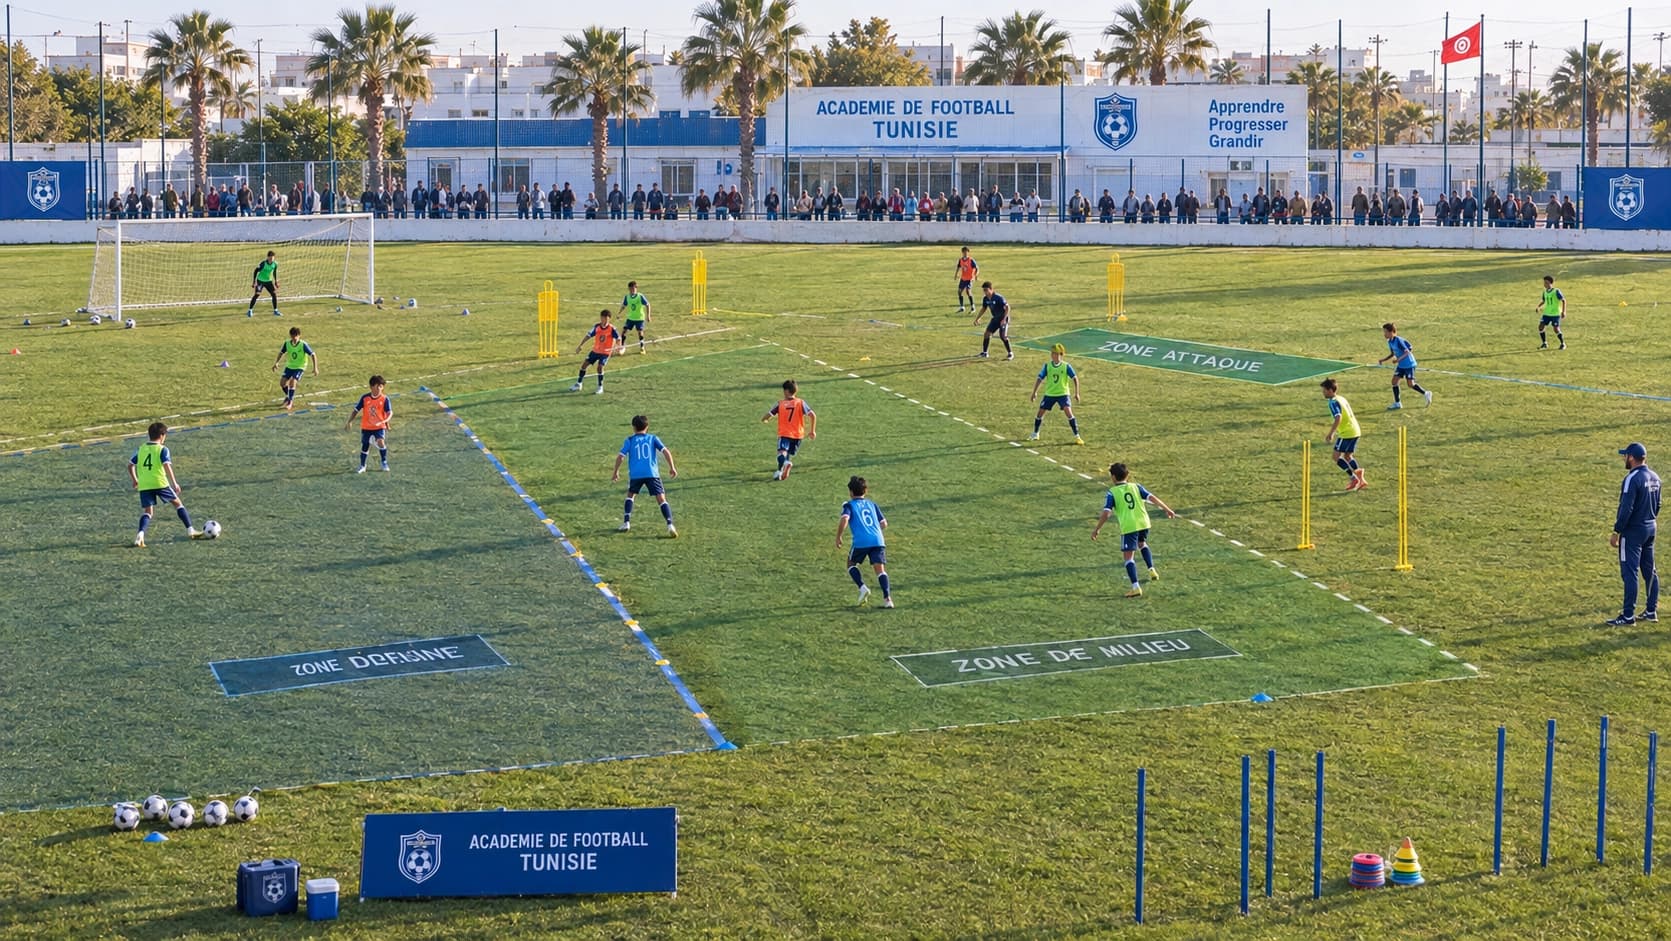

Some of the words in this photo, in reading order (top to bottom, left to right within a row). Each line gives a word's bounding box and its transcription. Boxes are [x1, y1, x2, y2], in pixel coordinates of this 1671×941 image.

[816, 100, 895, 115] ACADEMIE
[903, 100, 923, 115] DE
[931, 100, 1015, 115] FOOTBALL
[1208, 99, 1285, 116] Apprendre
[873, 120, 959, 139] TUNISIE
[1209, 117, 1289, 134] Progresser
[1209, 134, 1264, 149] Grandir
[1098, 341, 1158, 357] ZONE
[785, 407, 795, 422] 7
[634, 442, 651, 460] 10
[143, 453, 153, 471] 4
[1123, 492, 1135, 510] 9
[861, 508, 874, 527] 6
[952, 652, 1041, 673] ZONE
[1047, 647, 1093, 663] DE
[1098, 638, 1192, 658] MILIEU
[289, 659, 344, 676] ZONE
[469, 833, 545, 850] ACADEMIE
[549, 832, 569, 848] DE
[573, 832, 649, 848] FOOTBALL
[519, 853, 598, 872] TUNISIE
